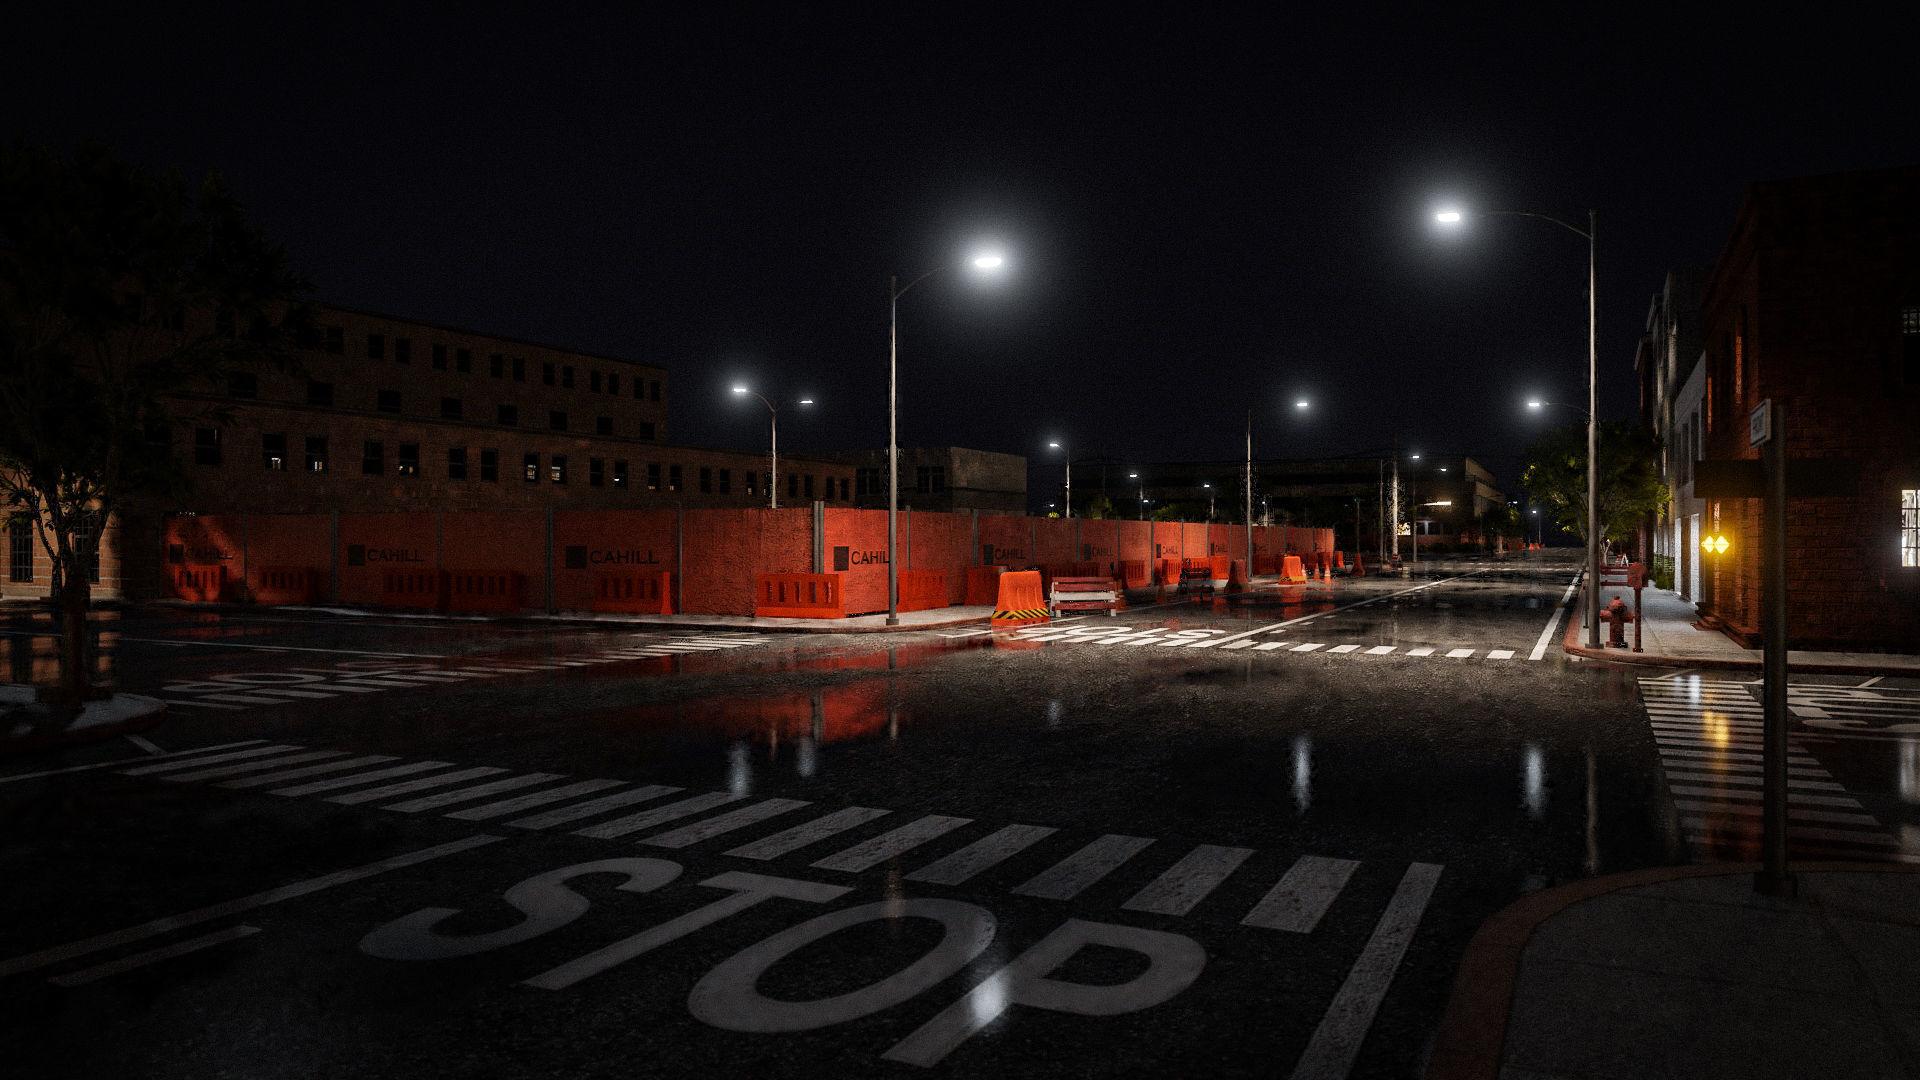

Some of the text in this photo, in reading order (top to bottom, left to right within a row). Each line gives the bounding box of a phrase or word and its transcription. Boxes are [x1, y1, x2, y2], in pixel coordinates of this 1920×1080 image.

[367, 549, 424, 563] CAHILL
[590, 550, 659, 565] CAHILL
[851, 551, 890, 565] CAHIL
[359, 856, 1207, 1068] STOP
